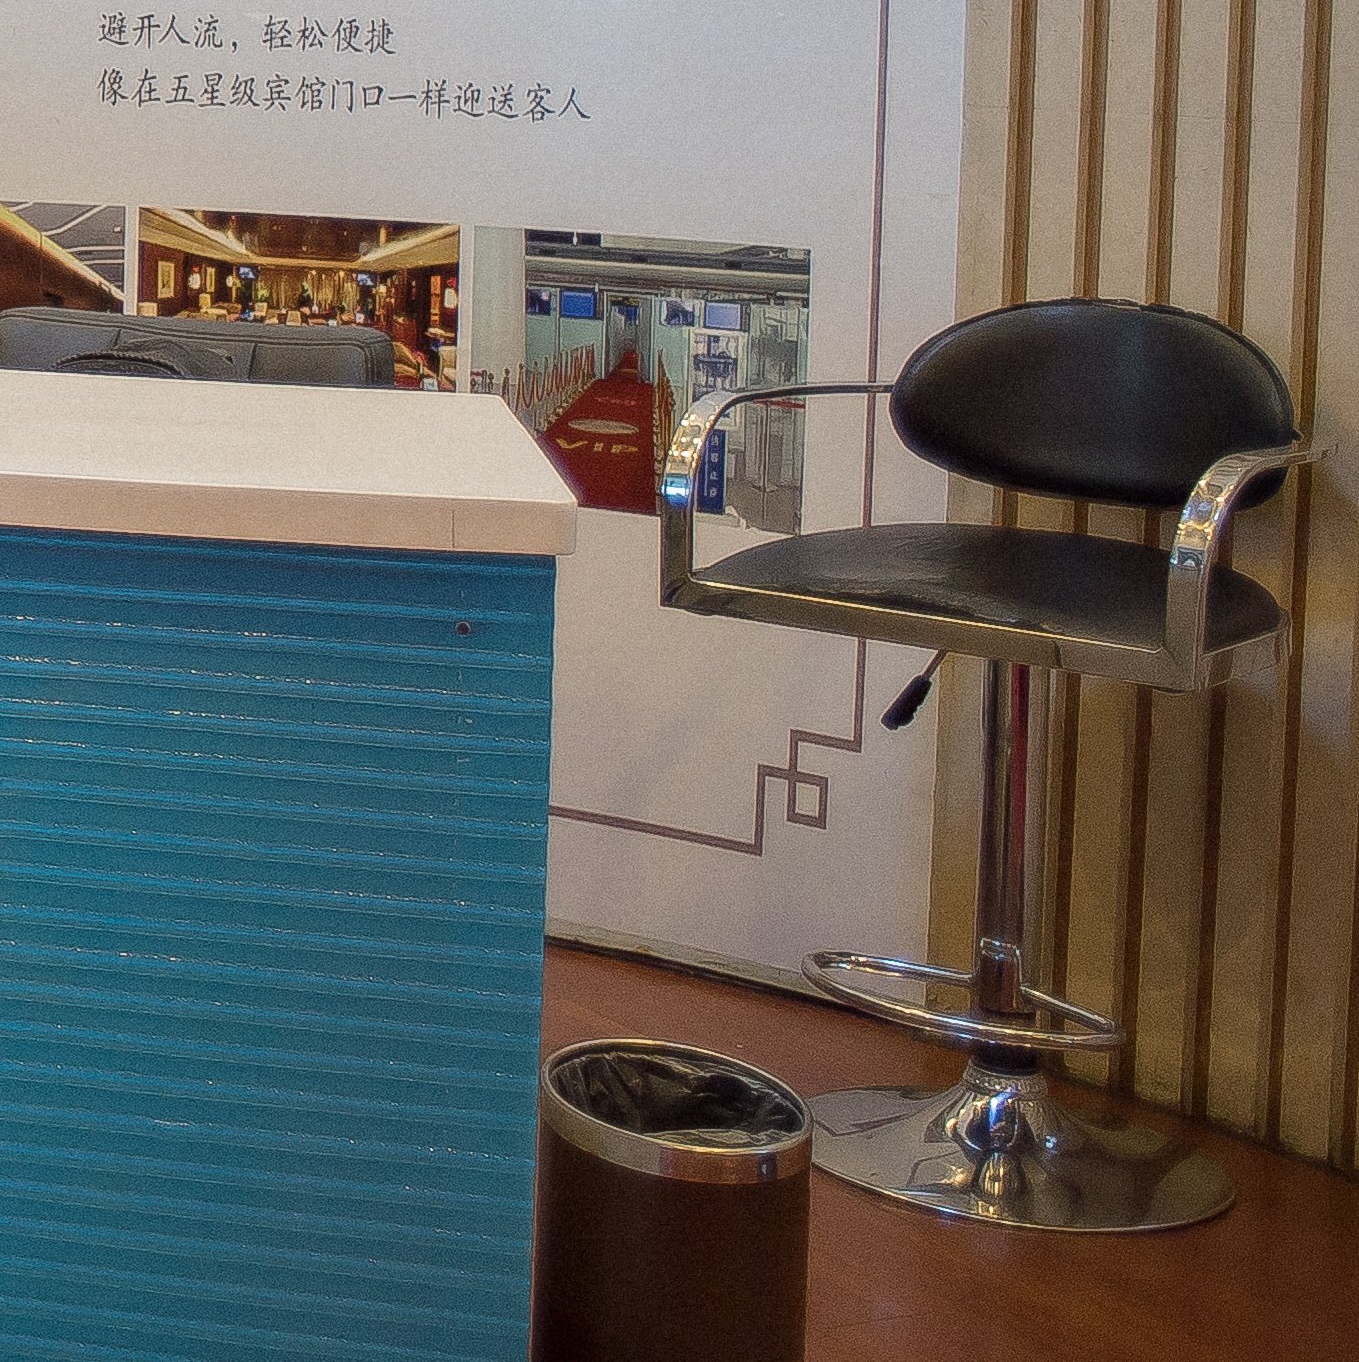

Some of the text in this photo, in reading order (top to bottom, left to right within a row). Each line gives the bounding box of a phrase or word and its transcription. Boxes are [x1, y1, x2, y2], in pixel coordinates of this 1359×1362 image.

[98, 14, 397, 55] 避开人流，轻松便捷
[96, 68, 591, 123] 像在五星级宾馆门口一样迎送客人
